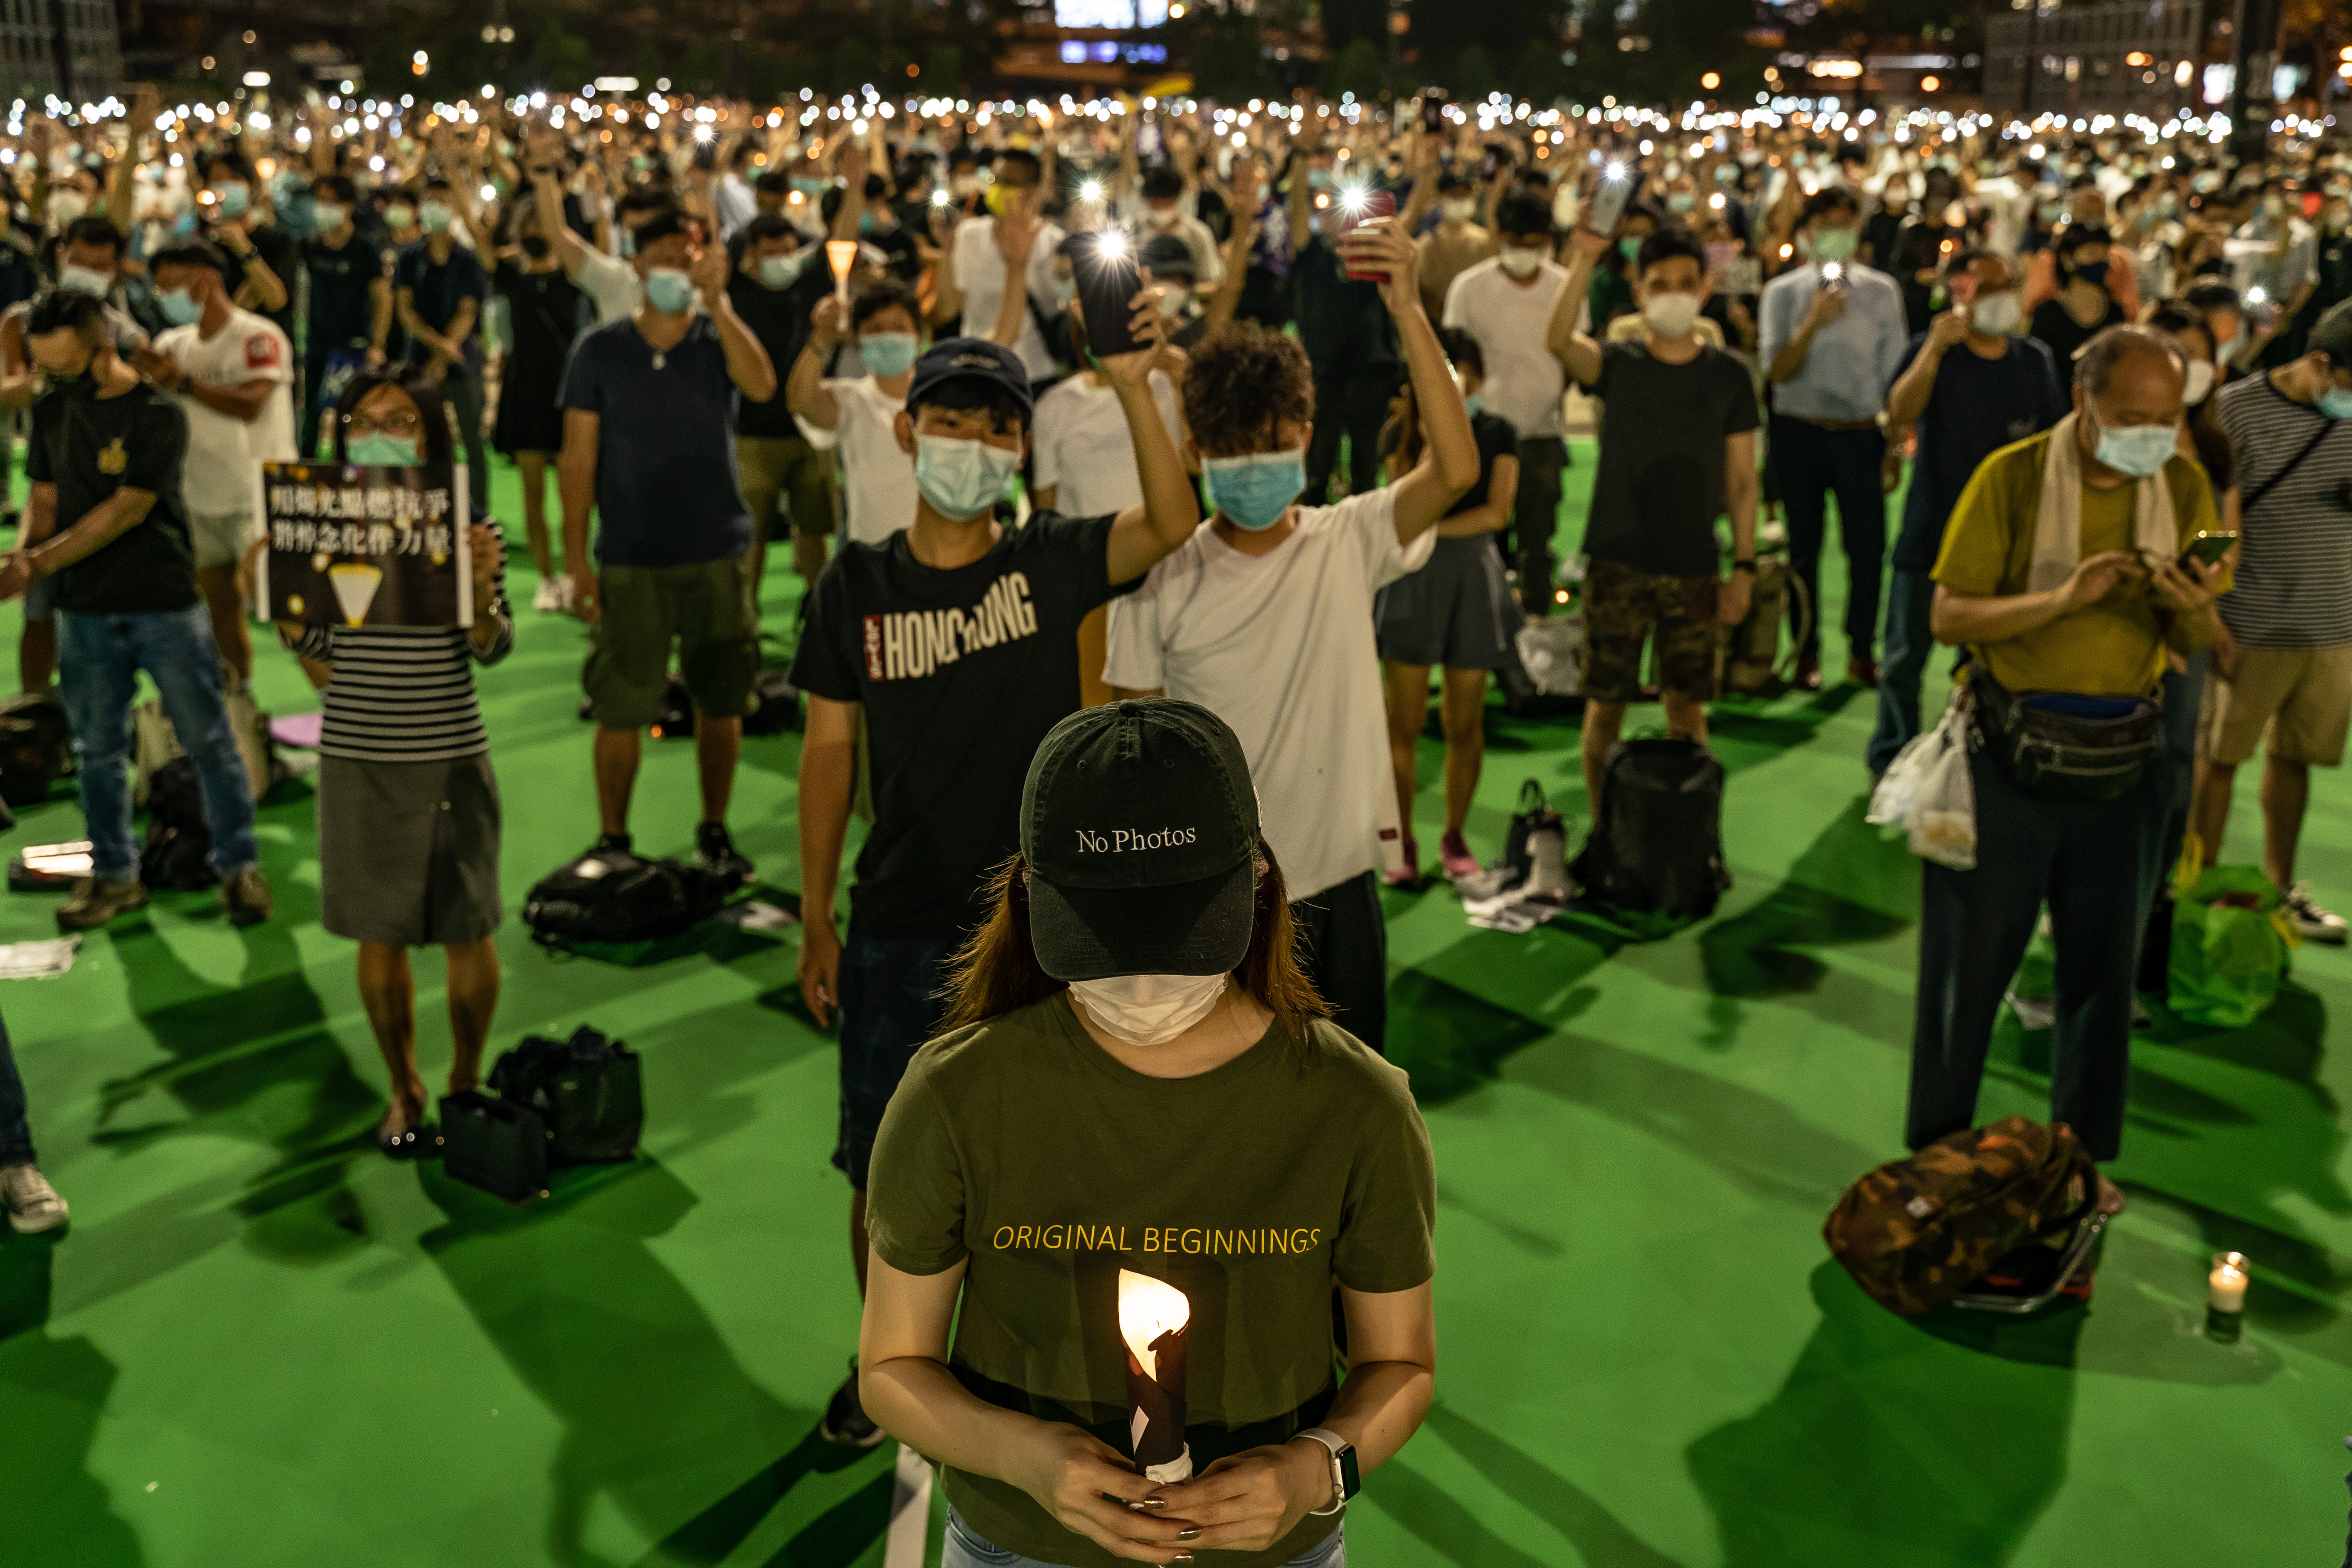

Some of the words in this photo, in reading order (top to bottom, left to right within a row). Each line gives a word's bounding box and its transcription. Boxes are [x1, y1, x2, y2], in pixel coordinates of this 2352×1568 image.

[1075, 830, 1108, 853] No
[1112, 827, 1196, 853] Photos
[993, 1225, 1132, 1250] ORIGINAL
[1144, 1227, 1320, 1254] BEGINNINGS
